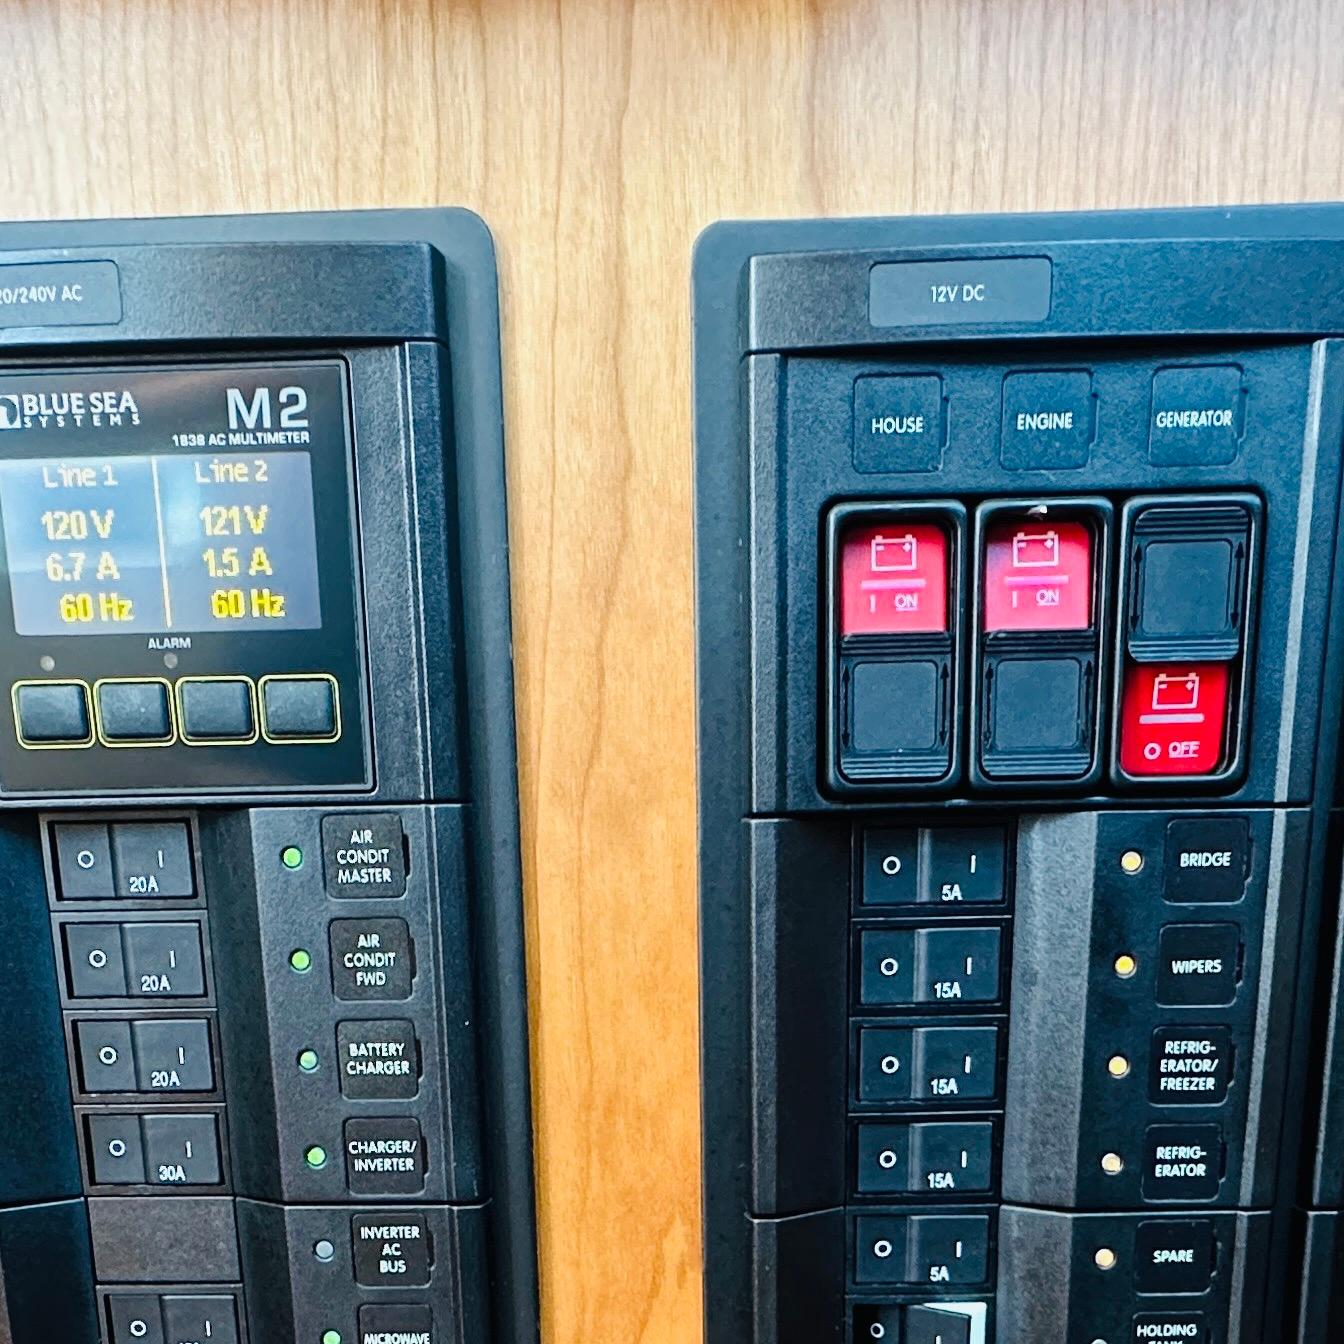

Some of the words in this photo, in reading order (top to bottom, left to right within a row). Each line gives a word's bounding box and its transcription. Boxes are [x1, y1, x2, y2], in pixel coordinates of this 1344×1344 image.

[61, 286, 83, 302] AC
[930, 285, 958, 302] 12V
[962, 284, 985, 301] DC
[24, 394, 84, 417] BLUE
[89, 392, 137, 414] SEA
[24, 414, 141, 428] SYSTEMS
[871, 417, 924, 434] HOUSE
[1016, 413, 1073, 431] ENGINE
[1156, 410, 1233, 428] GENERATOR
[208, 434, 226, 446] AC
[229, 431, 309, 446] MULTIMETER
[42, 465, 100, 488] Line
[105, 464, 118, 486] 1
[195, 461, 250, 484] Line
[254, 460, 268, 482] 2
[41, 511, 87, 541] 120
[200, 508, 242, 537] 121
[47, 554, 85, 582] 6.7
[96, 553, 120, 581] A
[205, 550, 241, 578] 1.5
[249, 549, 272, 576] A
[212, 590, 246, 620] 60
[251, 589, 286, 619] Hz
[894, 594, 918, 611] ON
[1036, 588, 1059, 606] ON
[60, 594, 94, 623] 60
[100, 592, 135, 622] Hz
[148, 637, 191, 649] ALARM
[1168, 741, 1200, 759] OFF
[351, 830, 373, 844] AIR
[337, 849, 388, 864] CONDIT
[1180, 852, 1231, 868] BRIDGE
[337, 868, 392, 883] MASTER
[1171, 959, 1222, 974] WIPERS
[935, 983, 961, 998] 15A
[349, 1043, 404, 1058] BATTERY
[1165, 1041, 1216, 1055] REFRIG-
[346, 1059, 410, 1075] CHARGER
[1160, 1059, 1218, 1073] ERATOR/
[1160, 1077, 1215, 1091] FREEZER
[348, 1141, 417, 1156] CHARGER/
[1156, 1146, 1206, 1160] REFRIG-
[354, 1157, 414, 1172] INVERTER
[1155, 1163, 1206, 1177] ERATOR
[159, 1166, 186, 1181] 30A
[360, 1226, 420, 1240] INVERTER
[382, 1244, 401, 1256] AC
[1153, 1250, 1193, 1263] SPARE
[379, 1260, 406, 1274] BUS
[1136, 1324, 1197, 1338] HOLDING
